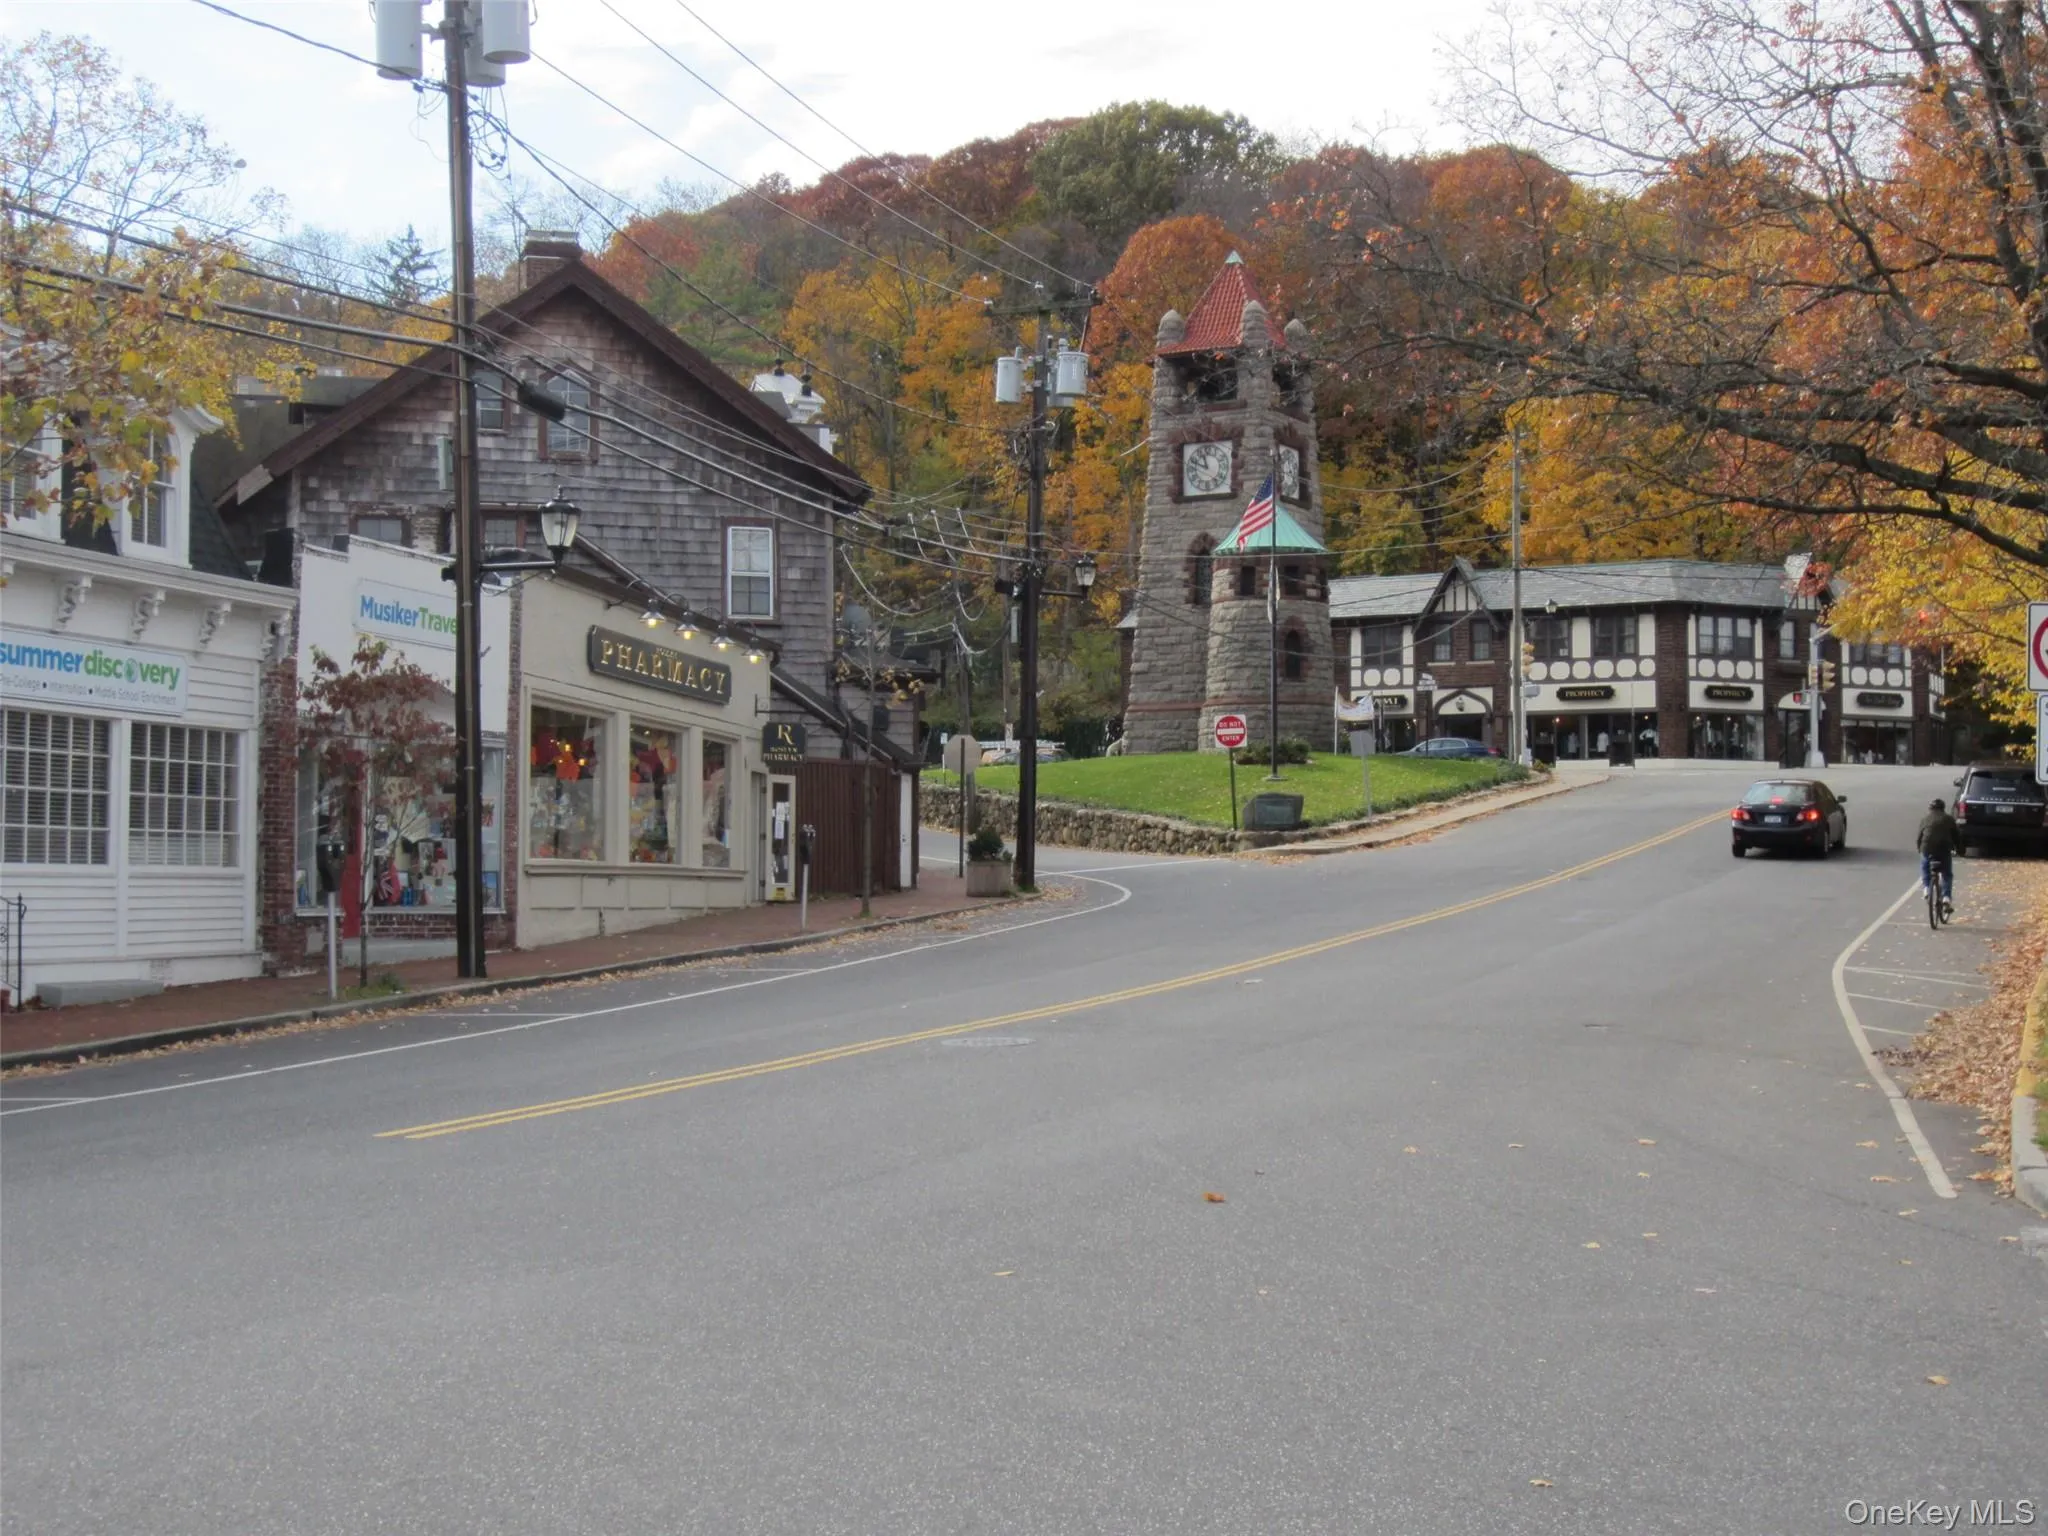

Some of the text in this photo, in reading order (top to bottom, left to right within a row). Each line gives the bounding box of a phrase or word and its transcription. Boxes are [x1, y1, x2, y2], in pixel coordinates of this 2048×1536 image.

[360, 595, 457, 635] MusikerTrave
[0, 642, 180, 690] summerdiscovery
[600, 639, 725, 694] PHARMACY
[1565, 688, 1606, 698] PROPHECY
[763, 752, 803, 761] PHARMACY
